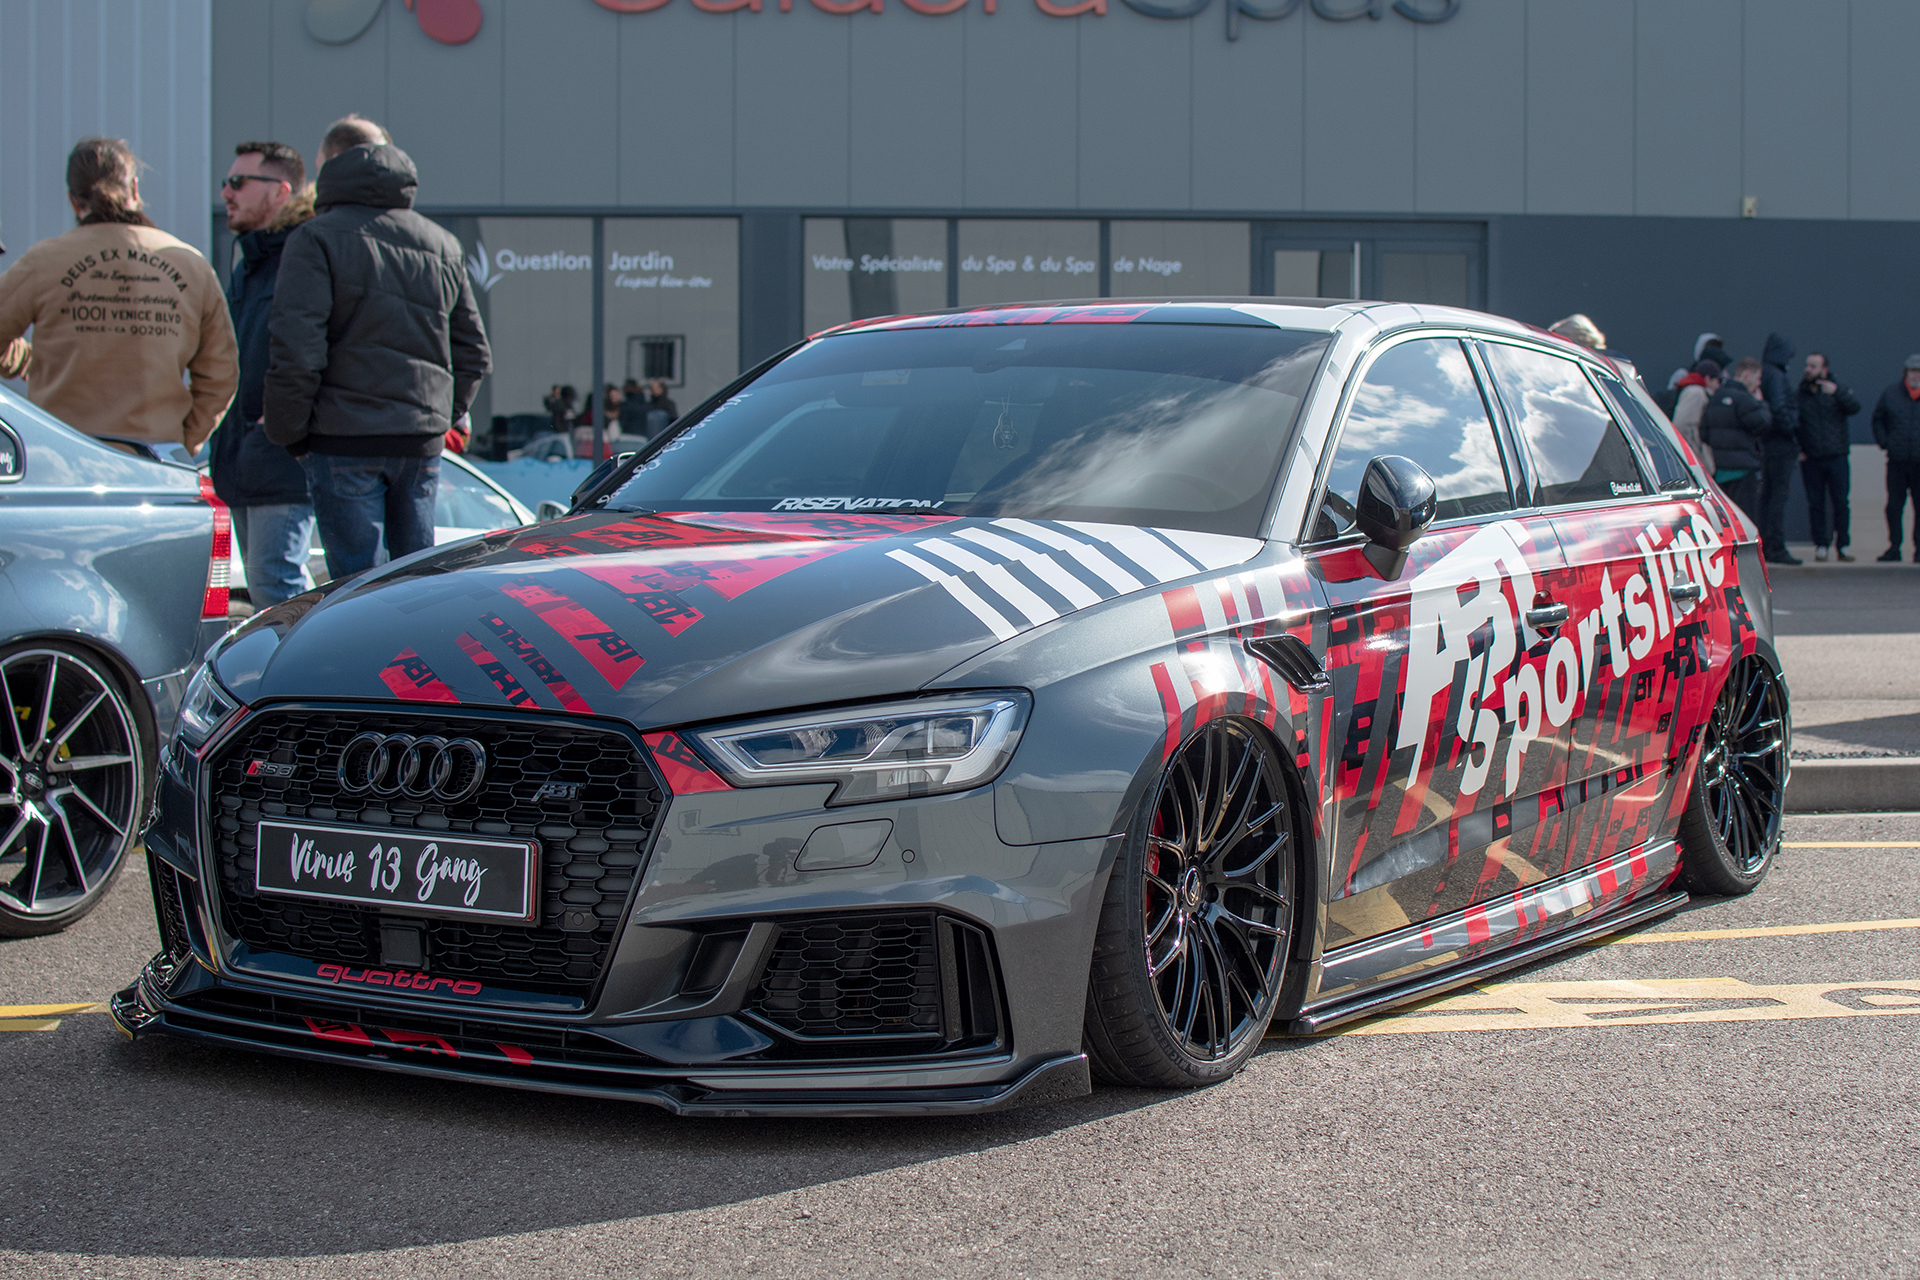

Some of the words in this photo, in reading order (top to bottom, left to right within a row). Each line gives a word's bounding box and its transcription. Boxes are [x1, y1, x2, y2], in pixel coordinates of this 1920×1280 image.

[60, 254, 97, 288] DEUS
[100, 248, 120, 262] EX
[127, 248, 188, 293] MACHINA
[495, 248, 592, 272] Question
[608, 251, 674, 271] Jardin
[812, 254, 854, 272] Votre
[859, 254, 944, 275] Spécialiste
[961, 255, 983, 272] du
[985, 256, 1016, 275] Spa
[1022, 256, 1035, 272] &
[1040, 256, 1063, 273] du
[1065, 257, 1095, 275] Spa
[1113, 257, 1134, 273] de
[1138, 257, 1182, 276] Nage
[72, 305, 106, 321] 1001
[111, 309, 152, 322] VENICE
[155, 311, 181, 324] BLVD
[75, 325, 105, 333] VENICE
[130, 325, 167, 336] 90291
[771, 497, 944, 511] RISENATION
[1397, 519, 1556, 791] ABT
[1457, 512, 1726, 797] Sportsline
[254, 762, 279, 775] RS
[531, 780, 586, 802] ABT
[289, 832, 356, 884] Virus
[368, 842, 401, 894] 13
[415, 842, 489, 907] Gang
[316, 963, 483, 996] quattro
[1149, 1018, 1189, 1071] MICHELIN
